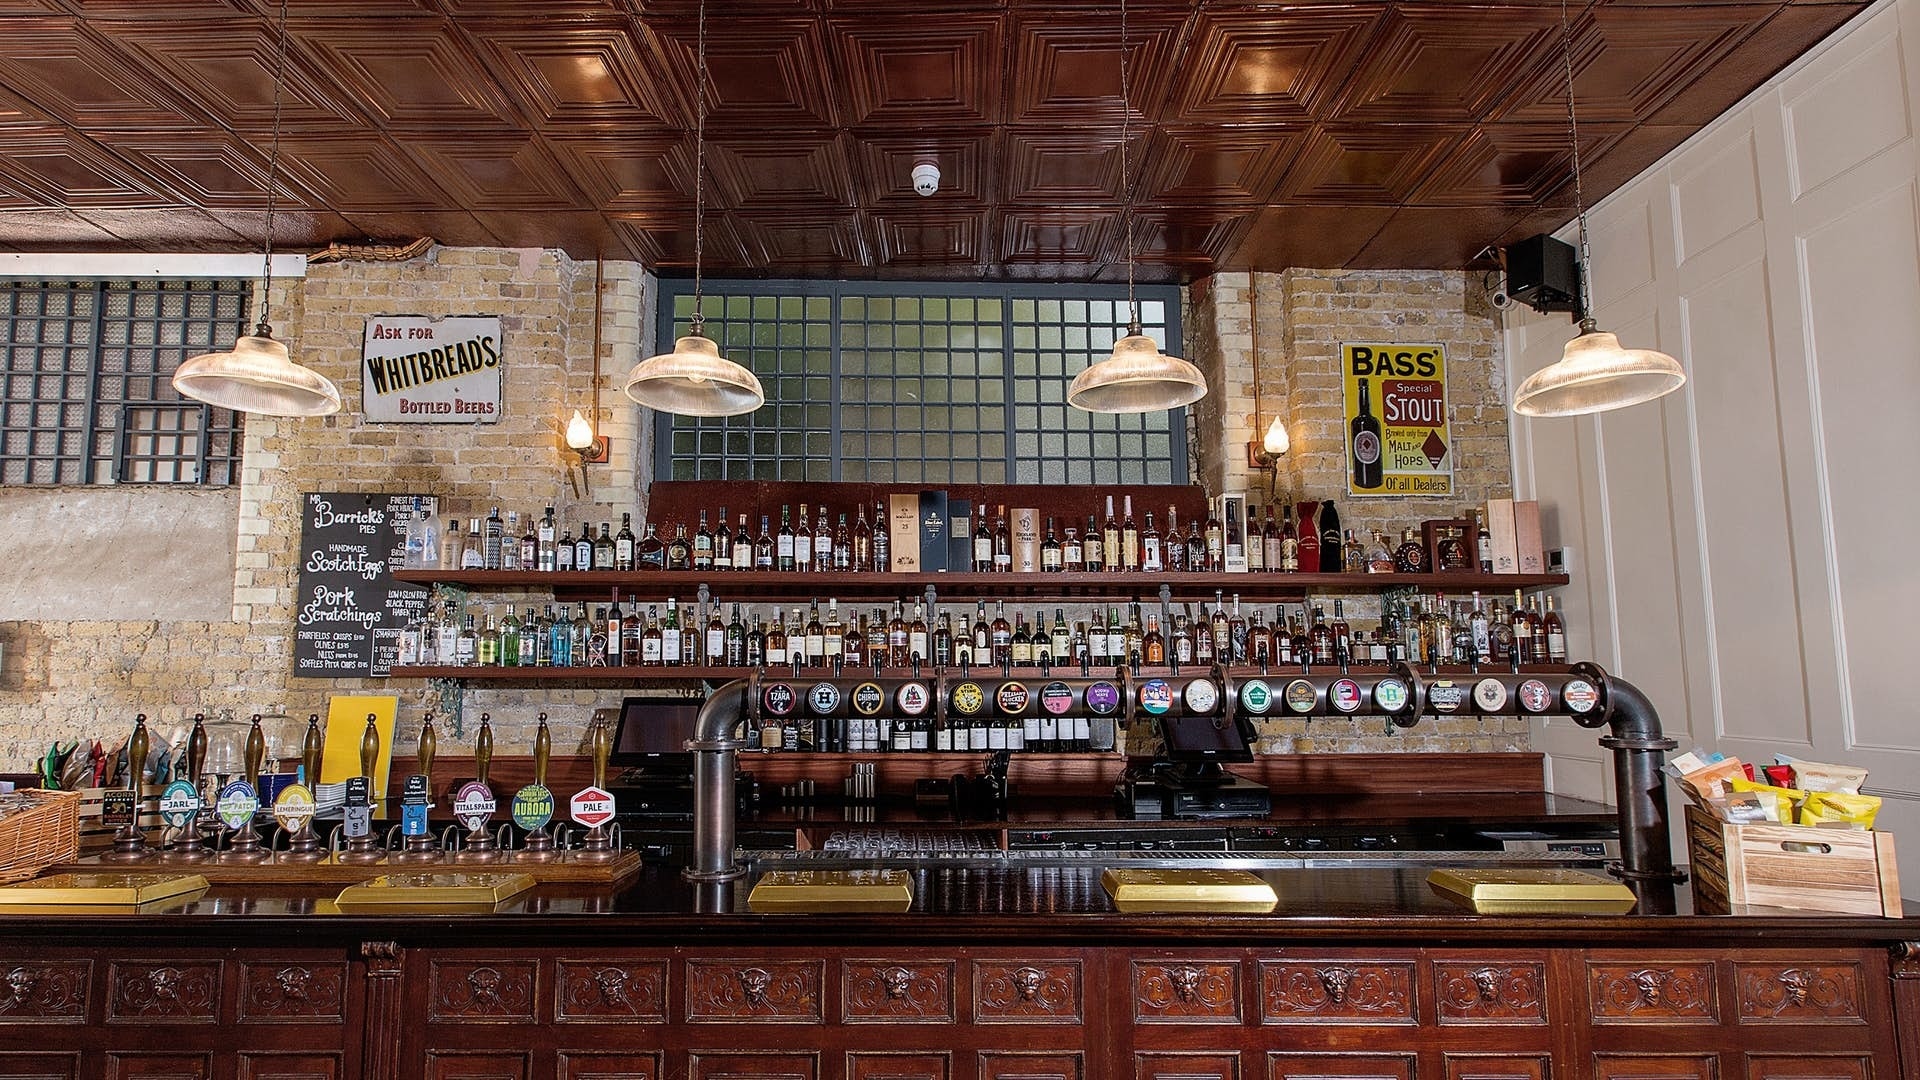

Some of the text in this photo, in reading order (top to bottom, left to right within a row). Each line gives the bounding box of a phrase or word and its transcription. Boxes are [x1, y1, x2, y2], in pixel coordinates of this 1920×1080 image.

[373, 324, 433, 339] ASK FOR
[367, 334, 499, 396] WHITBREAD'S
[1396, 383, 1432, 393] Special
[399, 398, 494, 414] BOTTLED BEERS
[1385, 393, 1443, 422] STOUT
[1388, 440, 1412, 454] MALT
[1394, 454, 1424, 469] HOPS
[1386, 477, 1447, 491] Of all Dealers
[314, 501, 385, 528] Barrick's
[359, 524, 376, 534] PIES
[328, 544, 367, 553] HANDMADE
[306, 550, 385, 580] Scotch Eggs
[313, 584, 356, 607] Pork
[298, 603, 382, 630] Scratchings
[298, 630, 331, 640] FAIRFIELDS
[314, 640, 336, 649] OLIVES
[317, 650, 335, 660] NUTS
[300, 658, 324, 669] SOFFLES
[770, 692, 791, 701] TZARA
[817, 691, 832, 704] H
[857, 693, 880, 702] CHIRON
[168, 800, 190, 808] JARL
[456, 801, 495, 811] VITAL SPARK
[514, 801, 551, 816] AURORA
[583, 802, 602, 812] PALE
